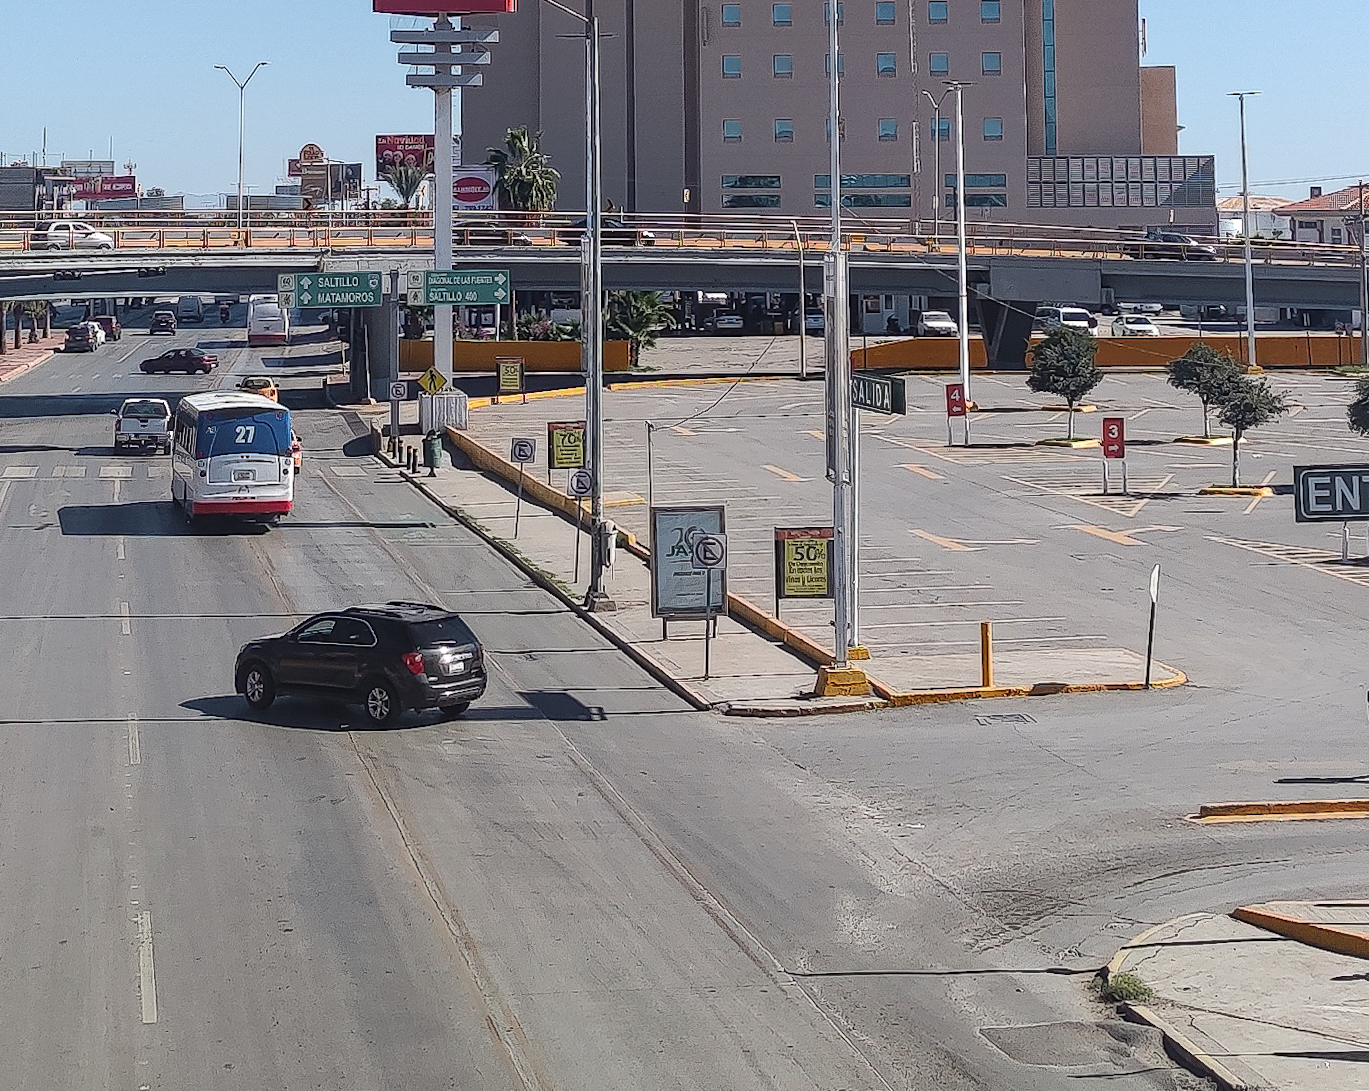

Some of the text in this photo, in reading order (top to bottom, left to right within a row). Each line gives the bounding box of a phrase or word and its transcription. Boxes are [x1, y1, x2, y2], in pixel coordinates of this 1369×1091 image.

[317, 276, 359, 288] SALTILLO
[317, 292, 374, 304] MATAMOROS
[429, 291, 478, 302] SALTILLO 400
[852, 379, 891, 409] SALIDA
[950, 389, 961, 402] 4
[235, 425, 256, 444] 27
[1108, 424, 1119, 438] 3
[1307, 475, 1369, 512] EN
[793, 545, 826, 561] 50%
